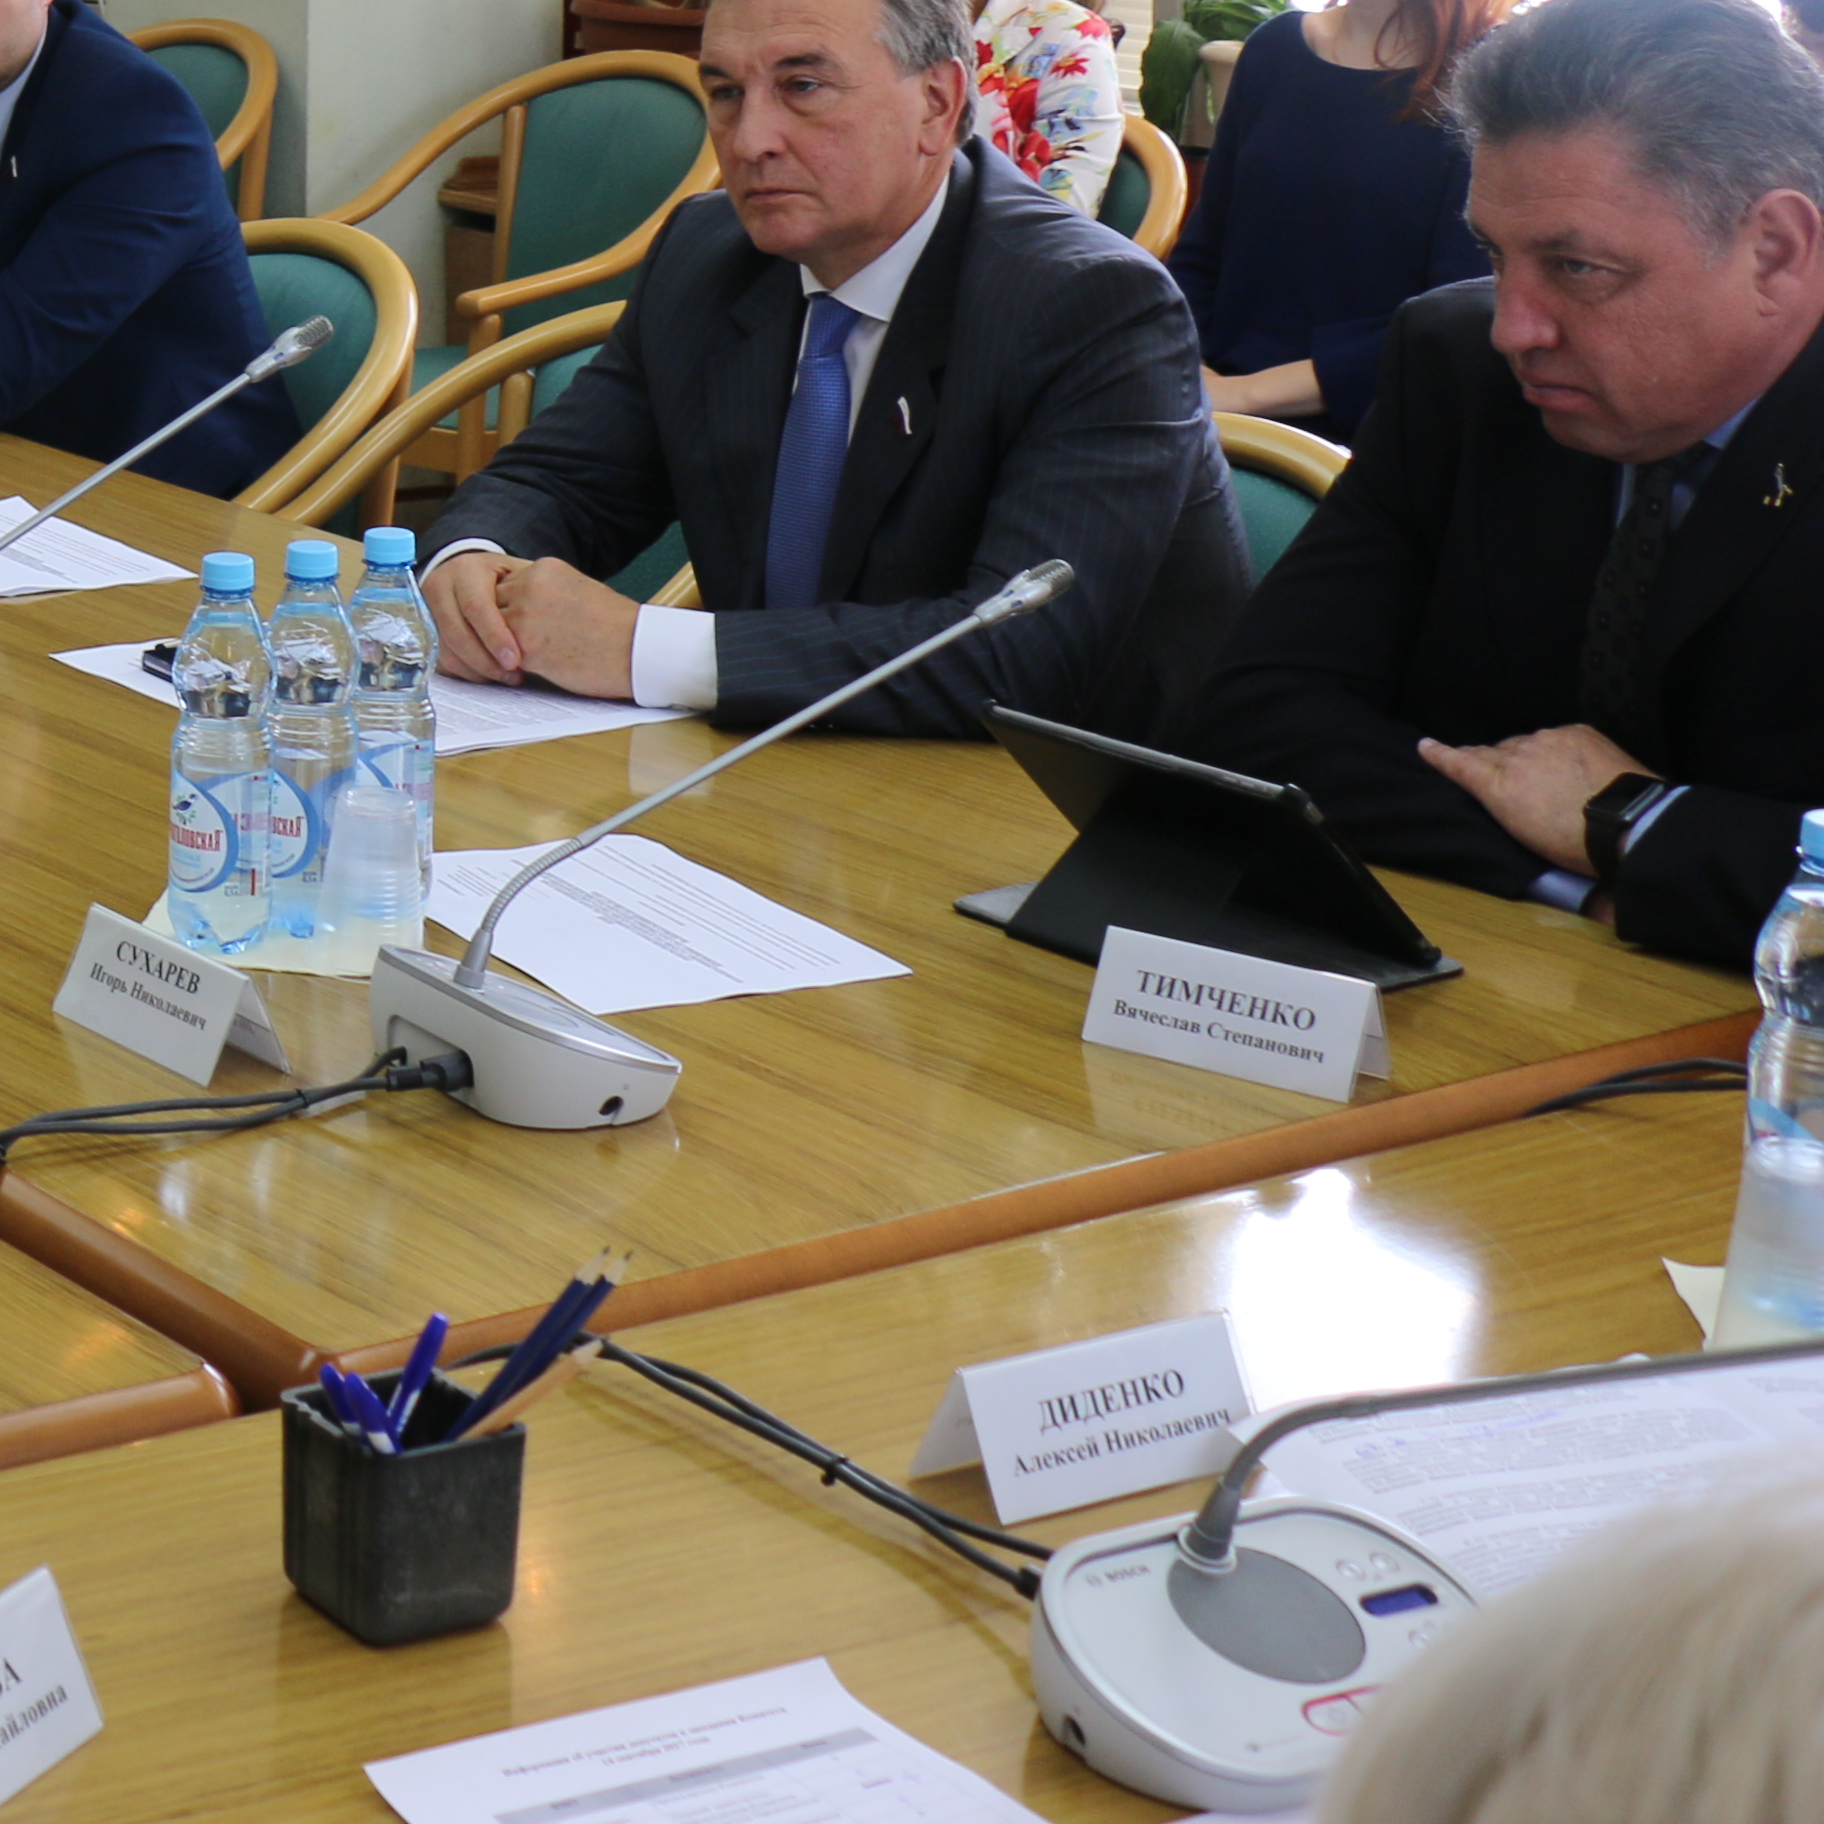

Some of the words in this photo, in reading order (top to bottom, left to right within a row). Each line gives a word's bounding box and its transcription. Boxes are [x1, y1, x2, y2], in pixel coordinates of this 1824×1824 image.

[90, 962, 127, 993] Игорь
[130, 981, 207, 1030] Николаевич
[116, 940, 201, 994] СУХАРЕВ
[1137, 969, 1316, 1031] ТИМЧЕНКО
[1113, 999, 1201, 1033] Вячеслав
[1207, 1022, 1325, 1064] Степанович
[1038, 1368, 1185, 1435] ДИДЕНКО
[1013, 1436, 1101, 1477] Алексей
[1103, 1408, 1232, 1454] Николаевич
